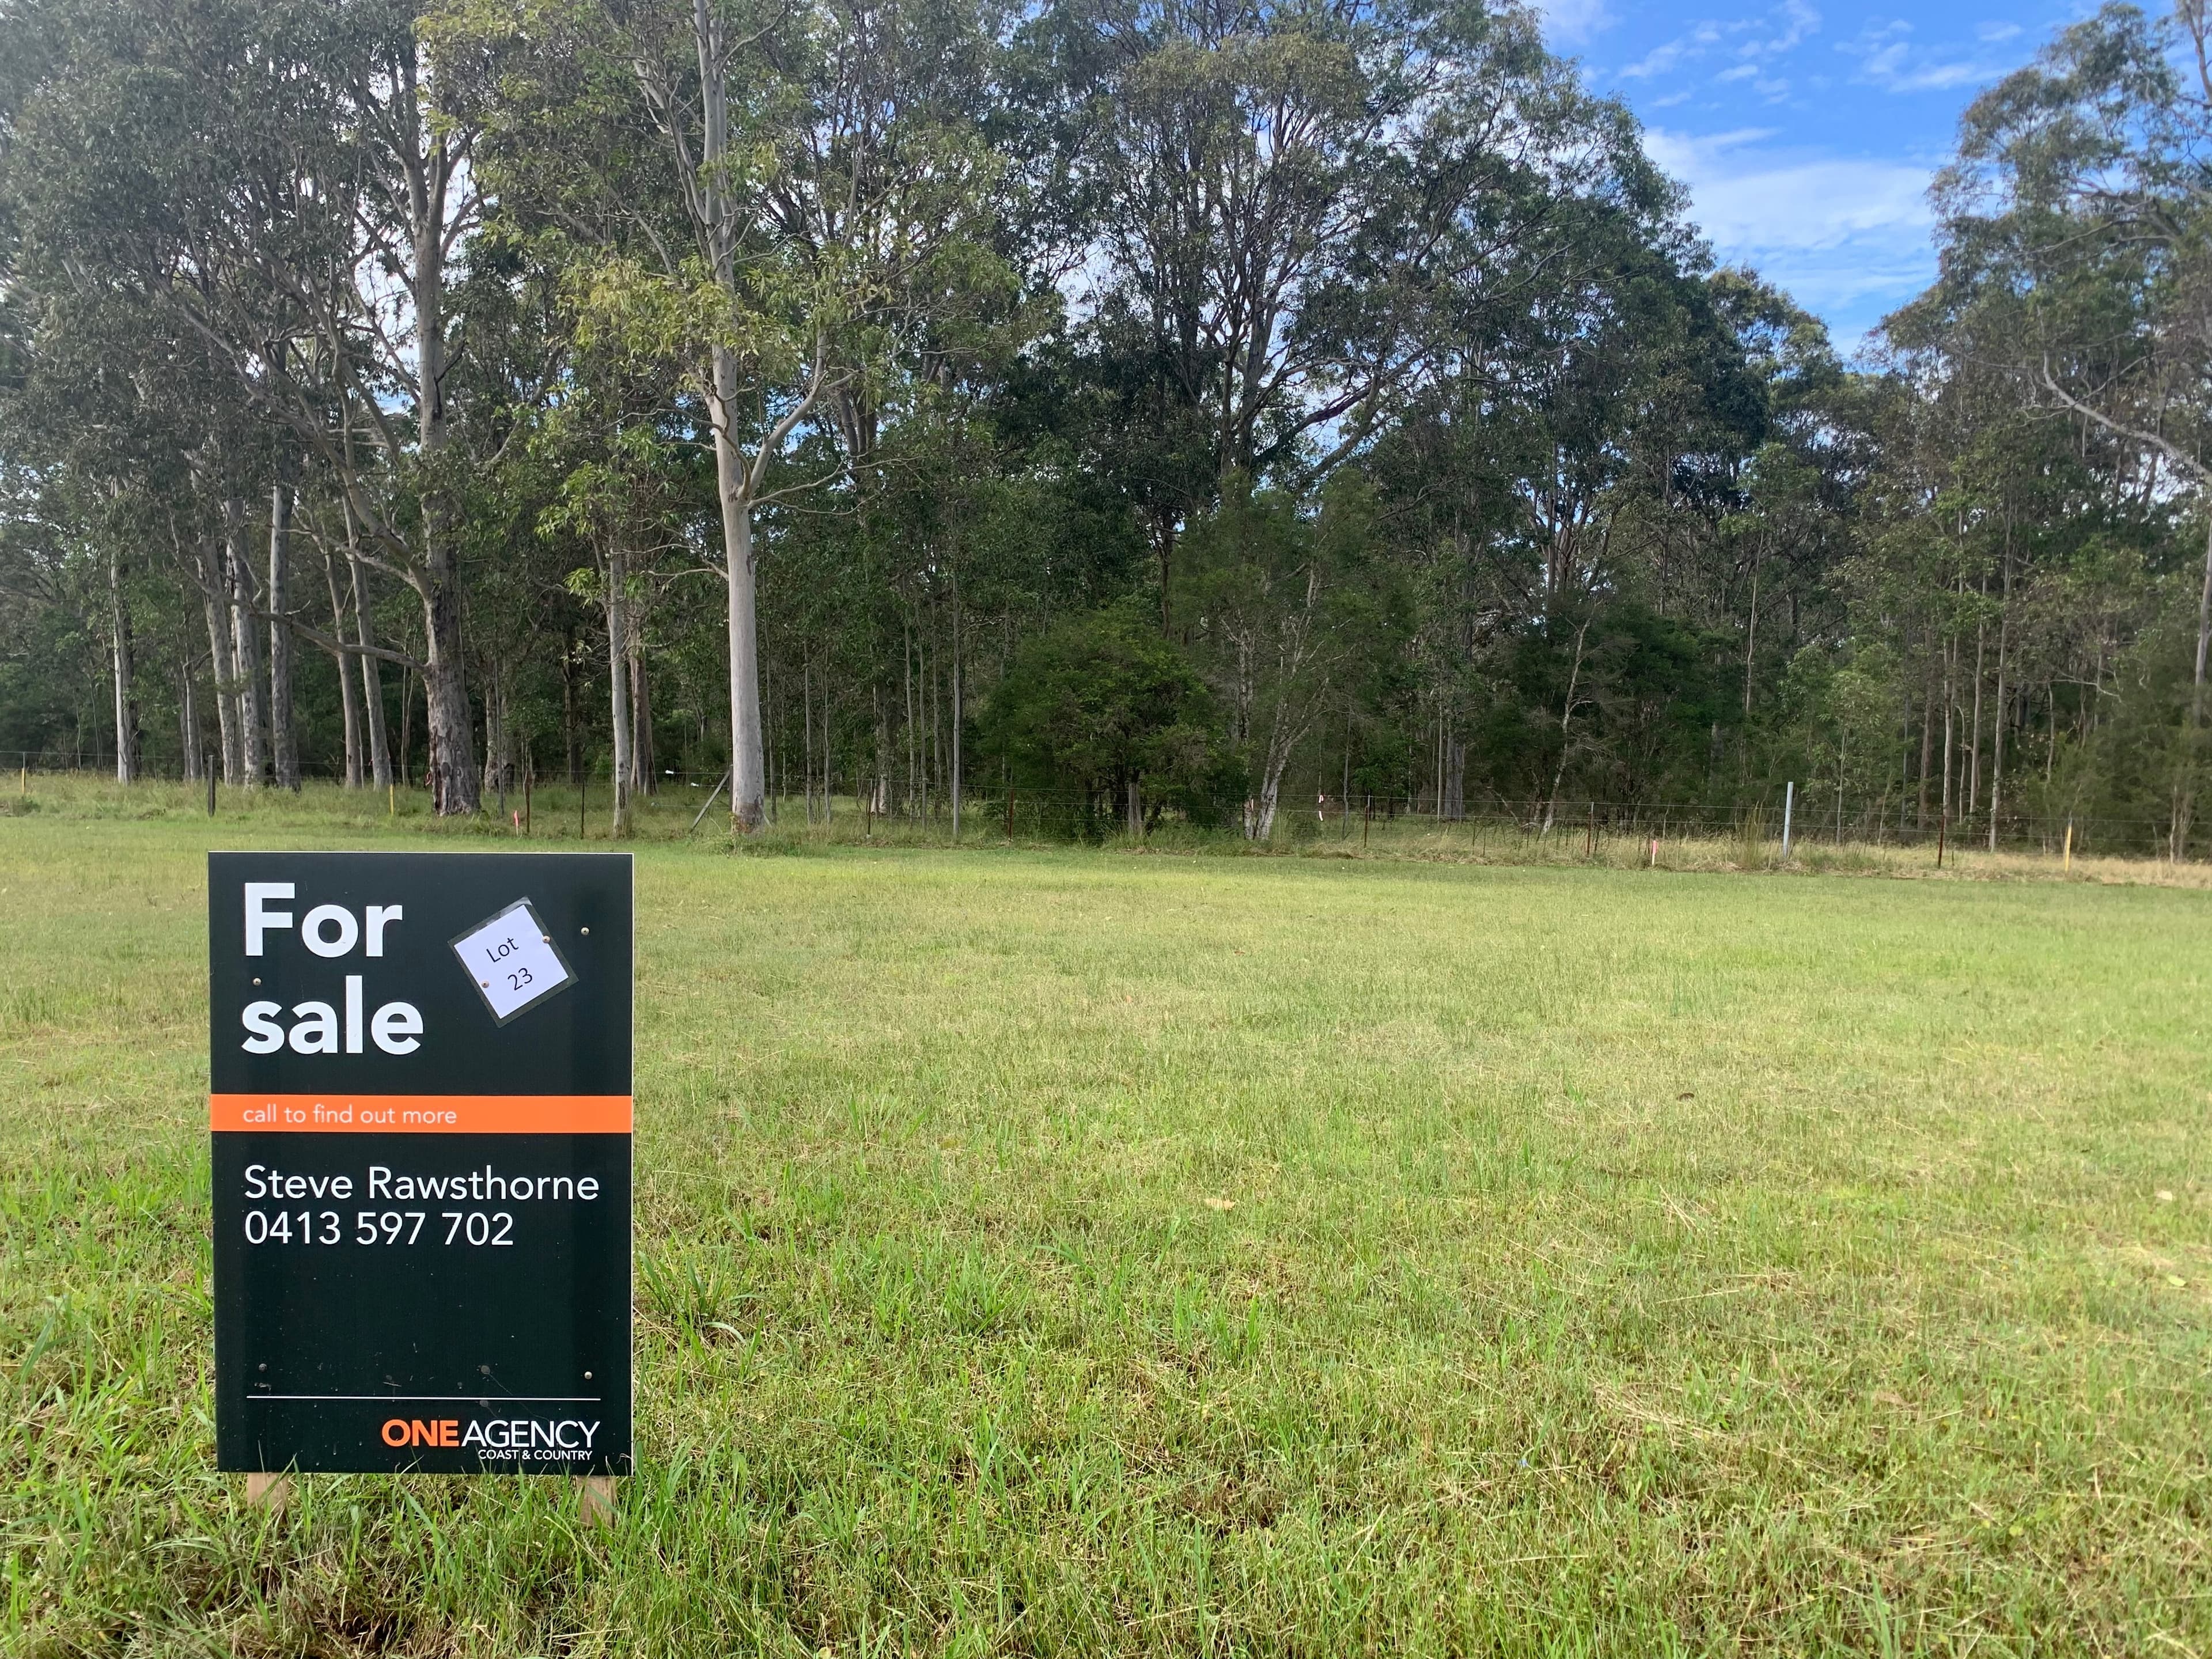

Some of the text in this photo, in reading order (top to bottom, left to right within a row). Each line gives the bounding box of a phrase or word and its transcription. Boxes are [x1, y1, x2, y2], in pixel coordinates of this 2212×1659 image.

[244, 882, 403, 958] For
[486, 937, 519, 963] Lot
[507, 968, 533, 991] 23
[241, 975, 423, 1055] sale
[243, 1103, 457, 1124] call to find out more
[244, 1164, 599, 1200] Steve Rawsthorne
[245, 1210, 513, 1245] 0413 597 702
[478, 1449, 593, 1460] COAST & COUNTRY
